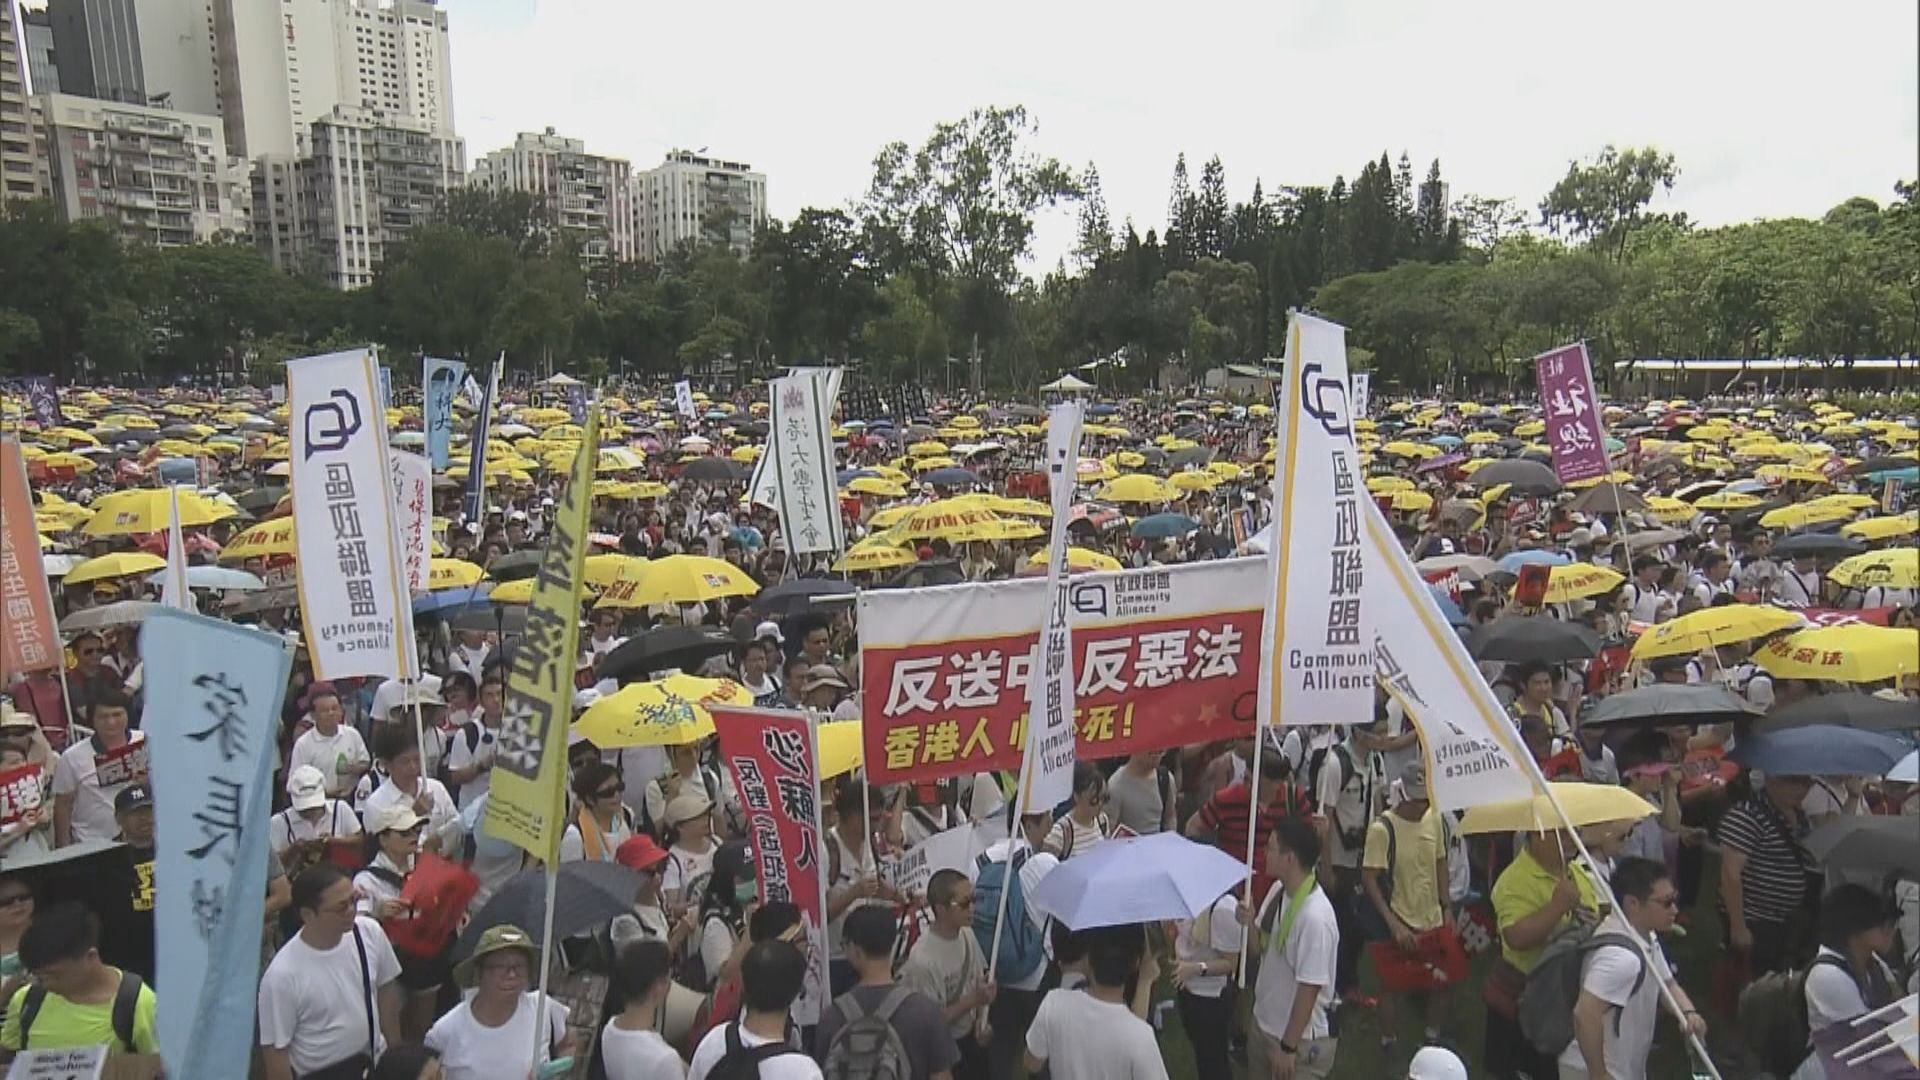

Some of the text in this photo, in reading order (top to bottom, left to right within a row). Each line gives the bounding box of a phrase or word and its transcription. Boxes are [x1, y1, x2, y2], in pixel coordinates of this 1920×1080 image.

[423, 31, 434, 71] THE
[1326, 451, 1363, 646] 區政聯盟
[1115, 592, 1171, 607] Community
[1116, 603, 1157, 617] Alliance
[1076, 624, 1243, 696] 反惡法
[884, 717, 994, 770] 香港人
